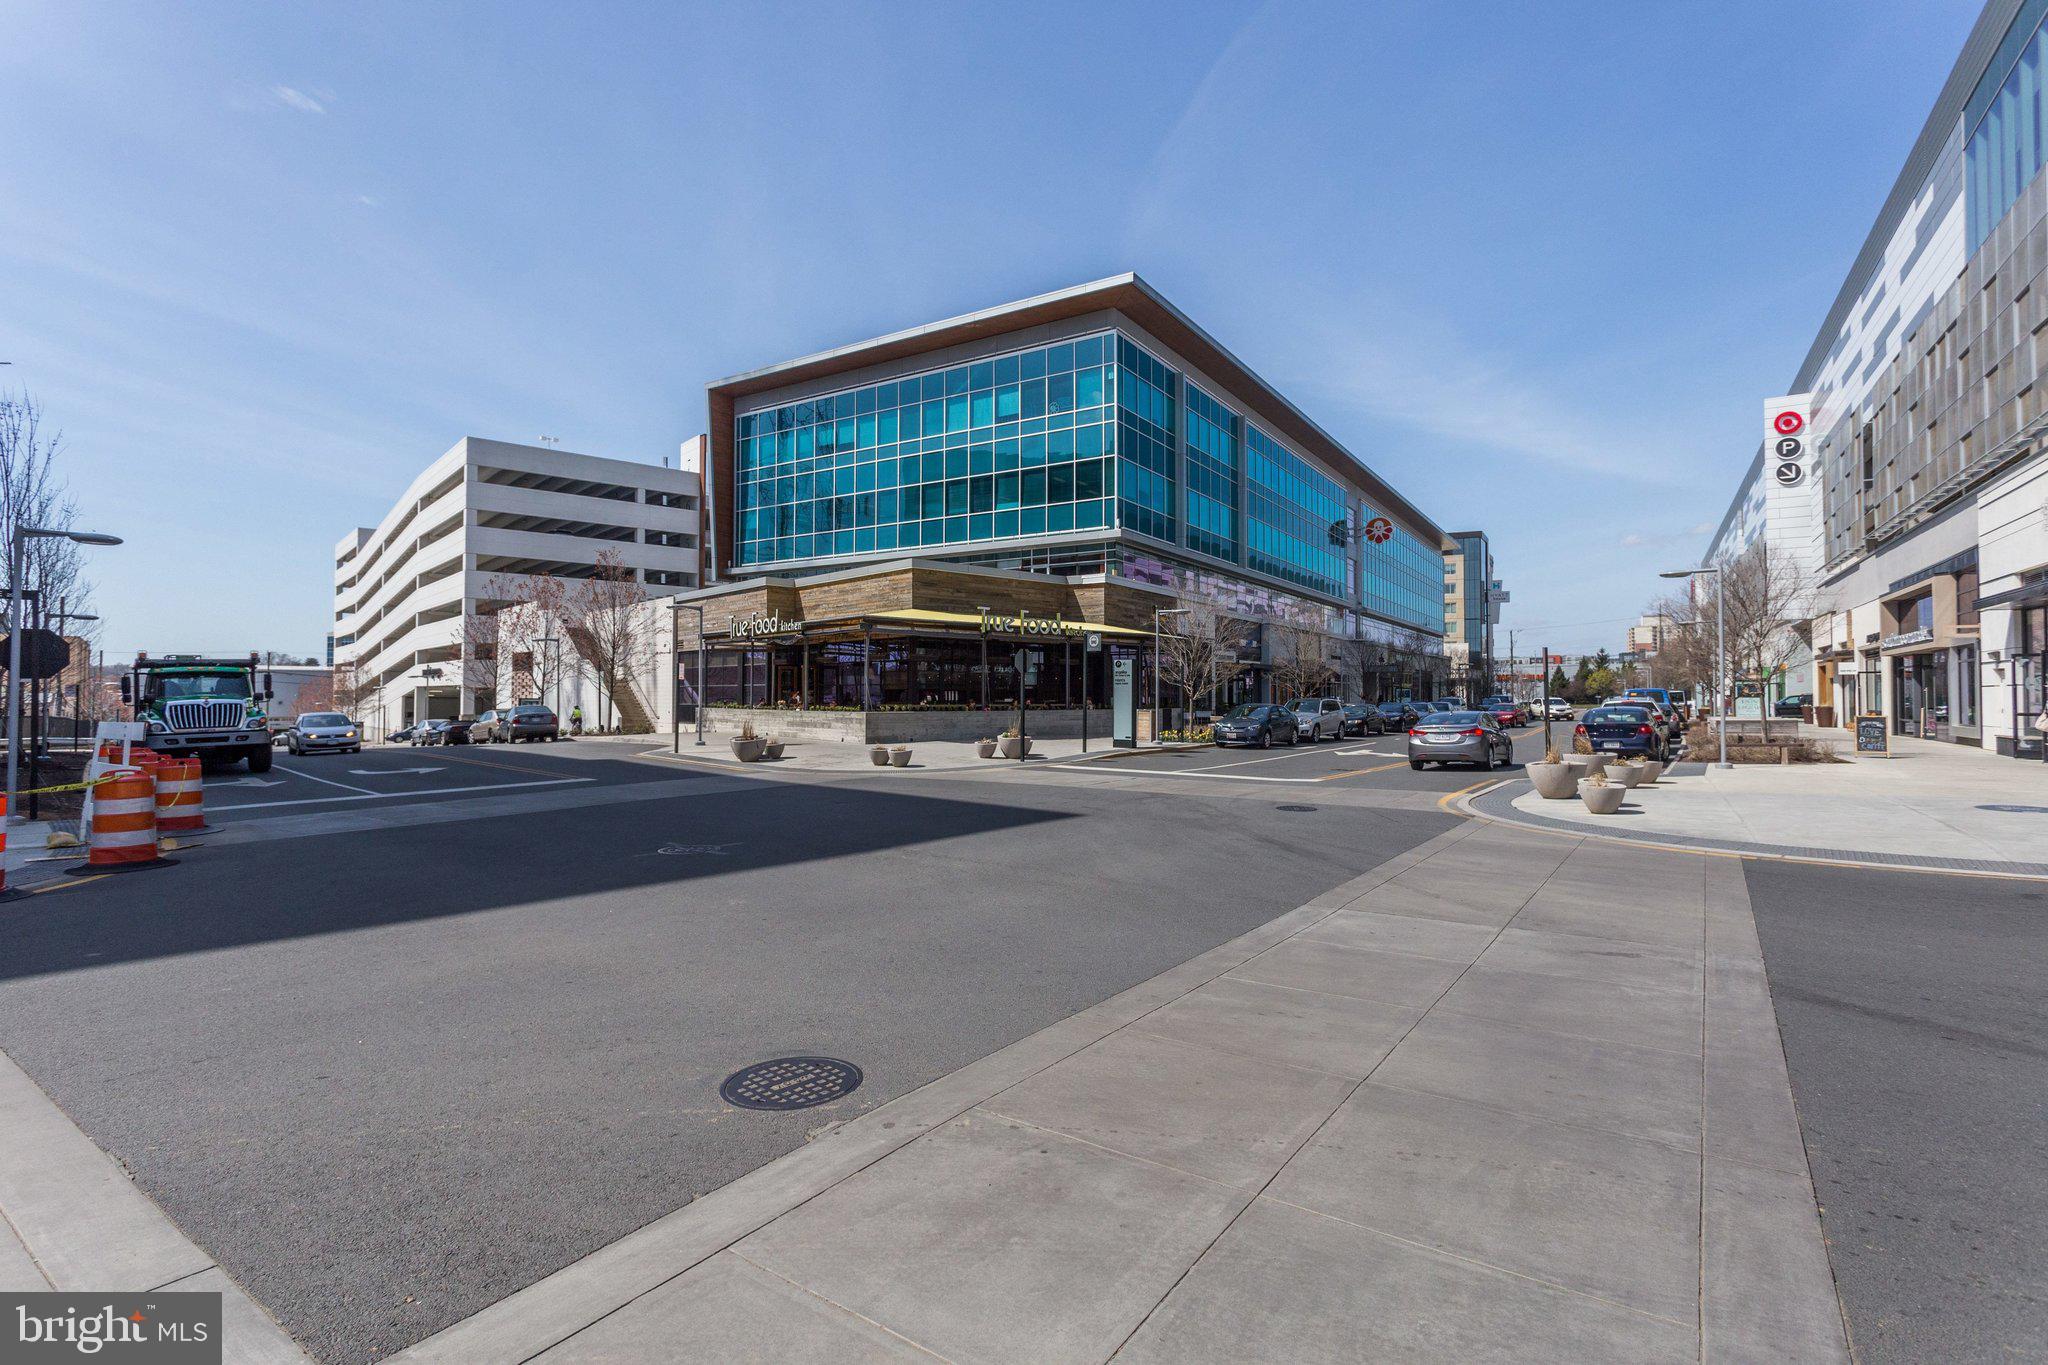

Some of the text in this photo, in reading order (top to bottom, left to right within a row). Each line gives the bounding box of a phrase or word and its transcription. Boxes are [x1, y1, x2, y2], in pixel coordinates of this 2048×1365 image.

[1782, 441, 1796, 455] P
[728, 609, 802, 639] True Food kitchen
[977, 606, 1014, 633] True
[1020, 609, 1061, 635] Food
